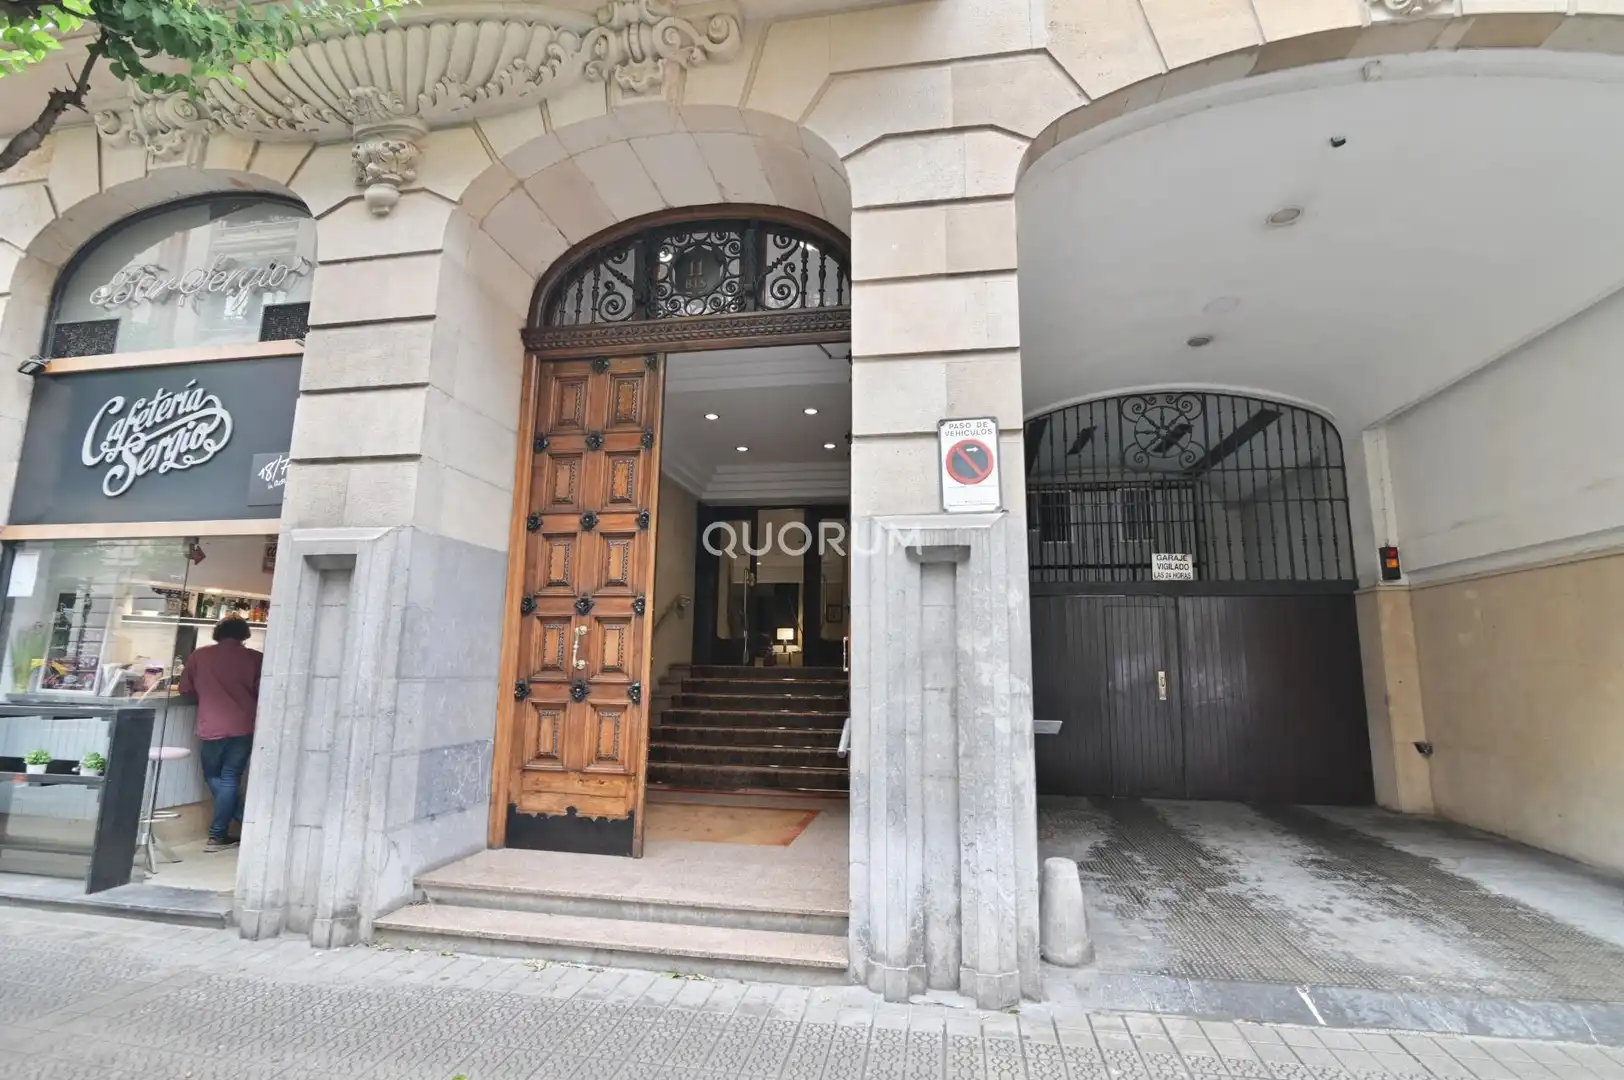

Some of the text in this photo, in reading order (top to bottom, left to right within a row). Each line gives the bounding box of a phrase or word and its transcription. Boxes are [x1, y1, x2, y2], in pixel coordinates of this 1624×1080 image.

[689, 260, 703, 276] 11
[82, 379, 214, 466] Cafetería
[948, 421, 988, 430] PASO DE
[945, 428, 993, 437] VEHICULOS
[102, 412, 232, 496] Sergio
[1156, 562, 1190, 570] VIGILADO
[1153, 571, 1165, 579] LAS
[1173, 571, 1192, 579] HORAS
